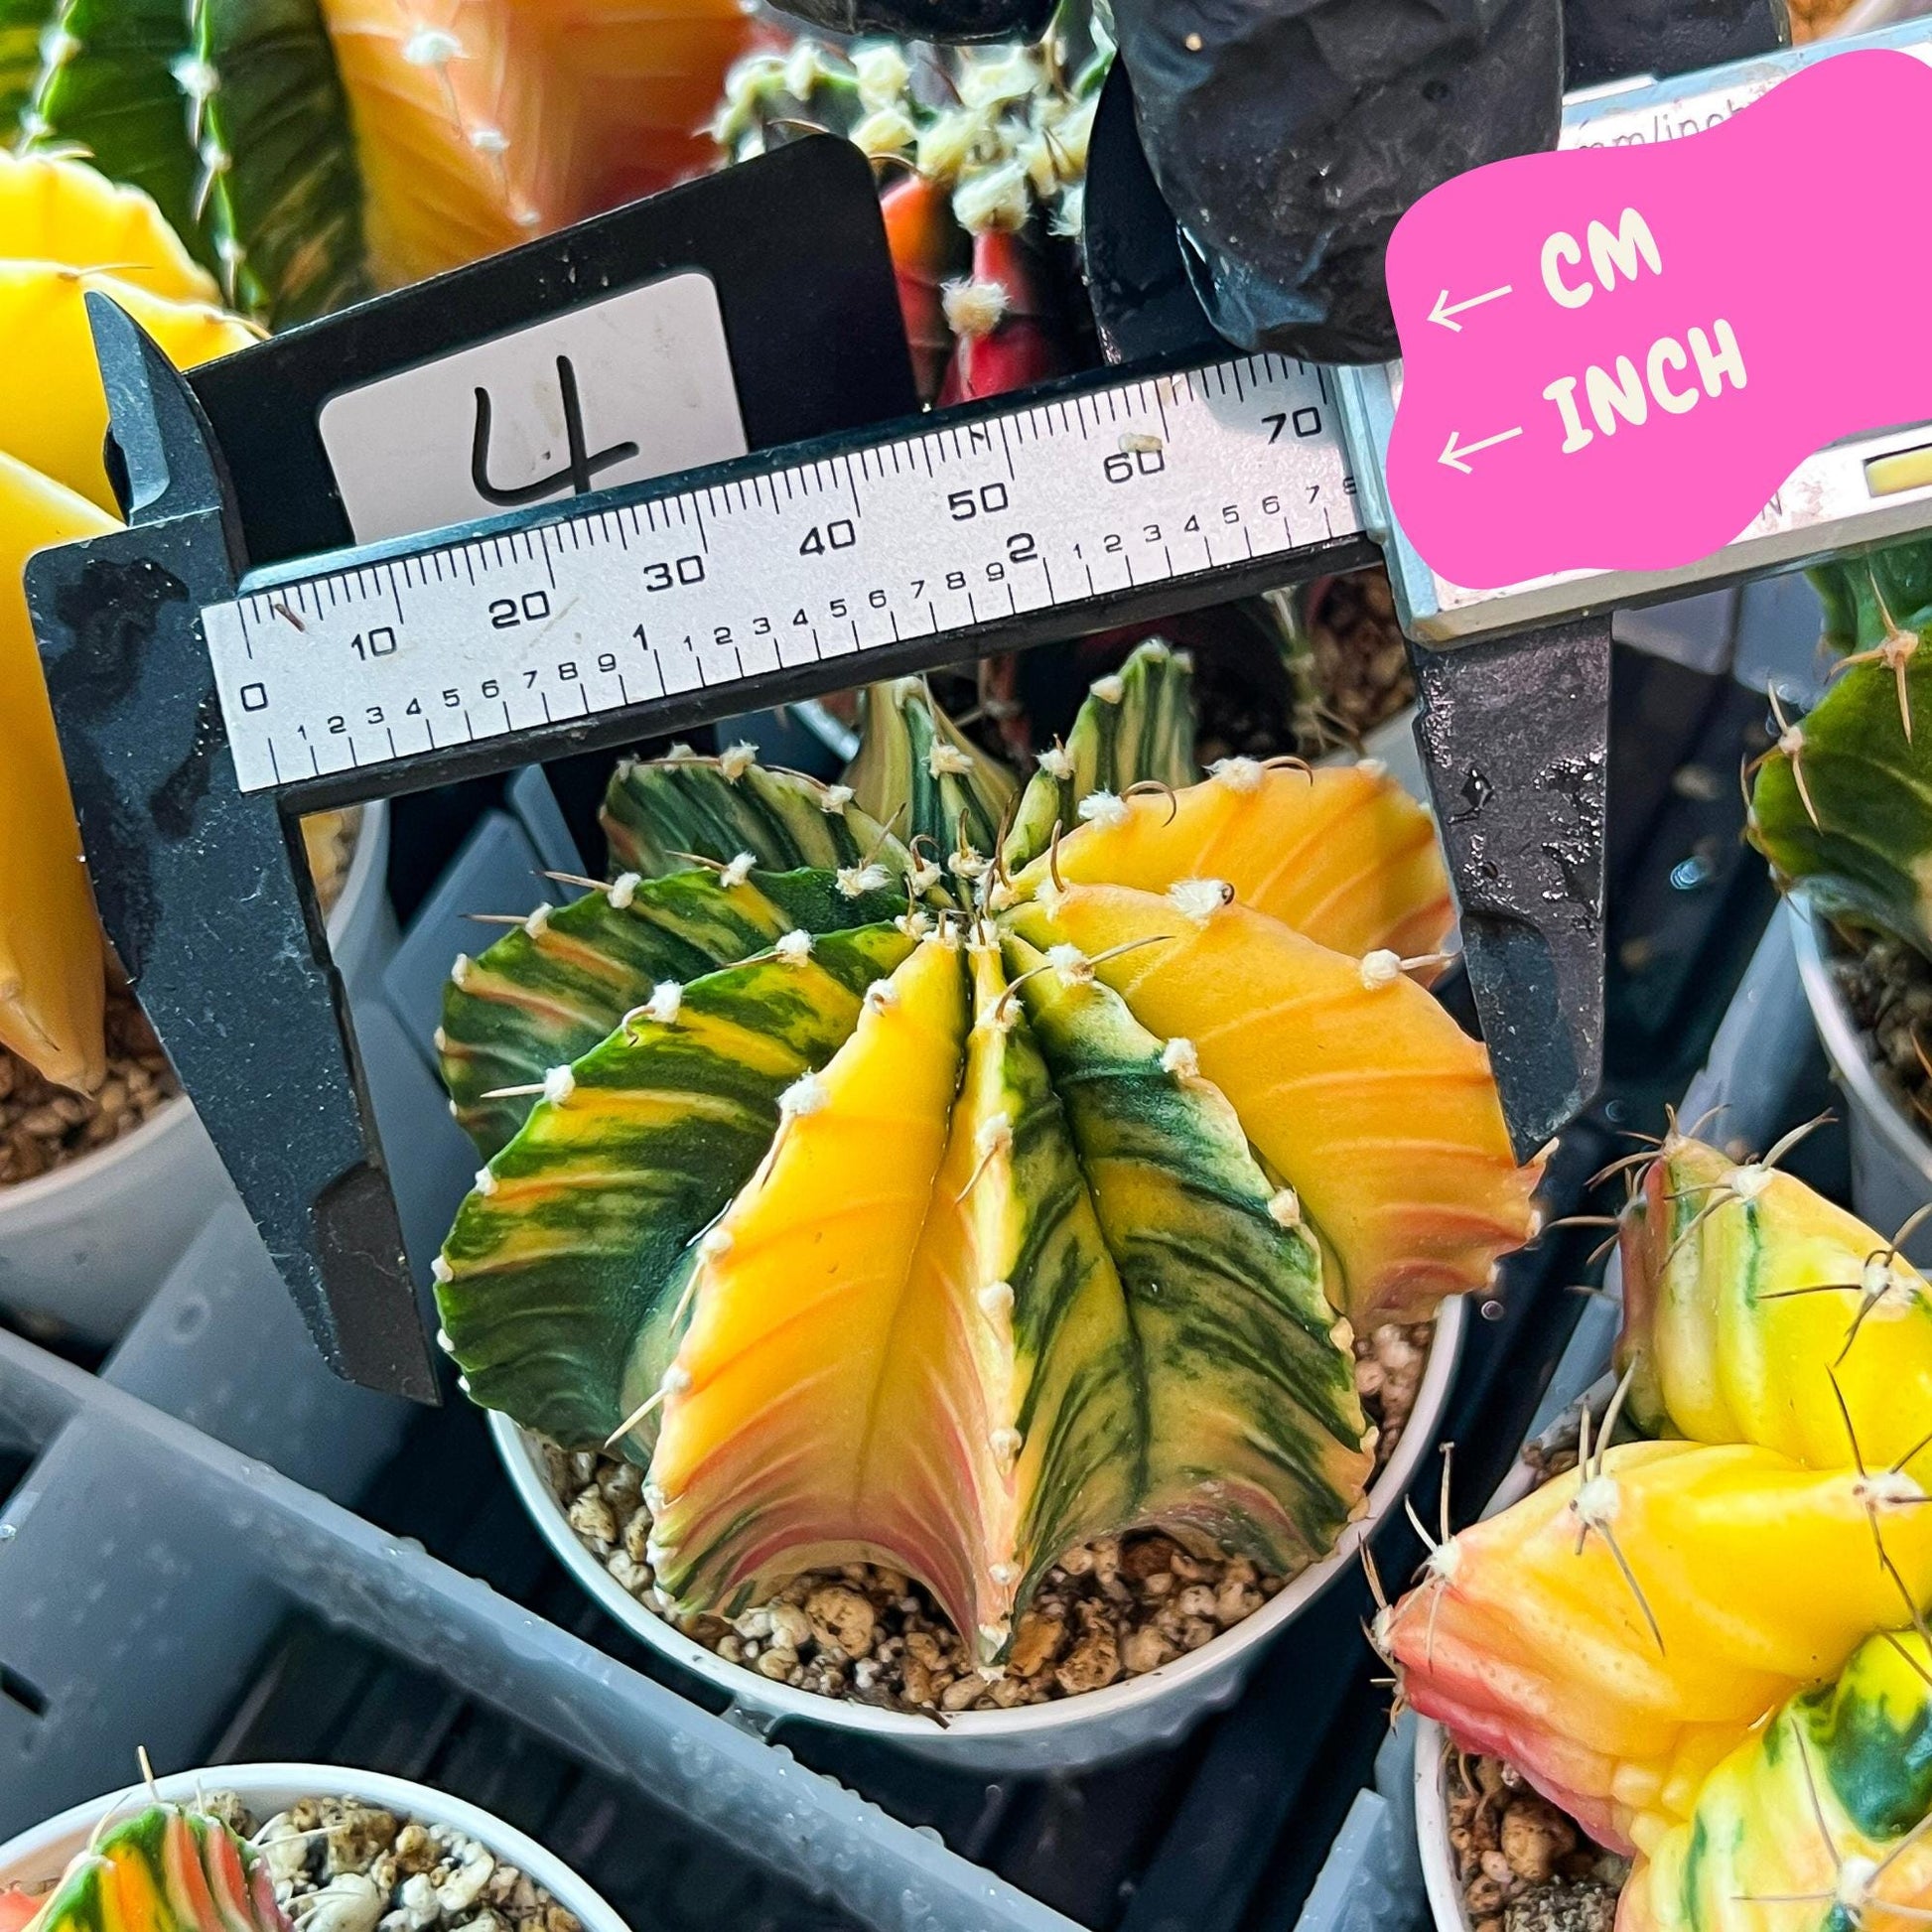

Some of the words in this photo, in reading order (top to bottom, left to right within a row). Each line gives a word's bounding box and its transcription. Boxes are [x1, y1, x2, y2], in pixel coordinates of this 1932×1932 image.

[240, 682, 269, 712] 0
[350, 626, 398, 661] 10
[487, 590, 551, 629] 20
[642, 555, 706, 593] 30
[798, 519, 857, 557] 40
[947, 483, 1010, 522] 50
[1103, 451, 1166, 484] 60
[1261, 406, 1322, 446] 70
[472, 355, 639, 506] 4
[296, 725, 308, 741] 1
[327, 716, 347, 735] 2
[365, 706, 385, 726] 3
[405, 697, 423, 716] 4
[443, 688, 461, 708] 5
[481, 679, 500, 699] 6
[522, 670, 538, 690] 7
[558, 662, 579, 681] 8
[597, 653, 618, 673] 9
[632, 623, 649, 651] 1
[682, 635, 693, 652] 1
[713, 626, 734, 646] 2
[752, 618, 771, 635] 3
[792, 608, 809, 627] 4
[829, 599, 848, 619] 5
[868, 590, 888, 610] 6
[909, 580, 925, 600] 7
[945, 571, 967, 591] 8
[985, 562, 1006, 583] 9
[1006, 533, 1038, 565] 2
[1072, 543, 1083, 560] 1
[1103, 534, 1124, 554] 2
[1143, 524, 1163, 543] 3
[1183, 514, 1200, 533] 4
[1222, 505, 1240, 525] 5
[1261, 495, 1281, 515] 6
[1305, 484, 1320, 505] 7
